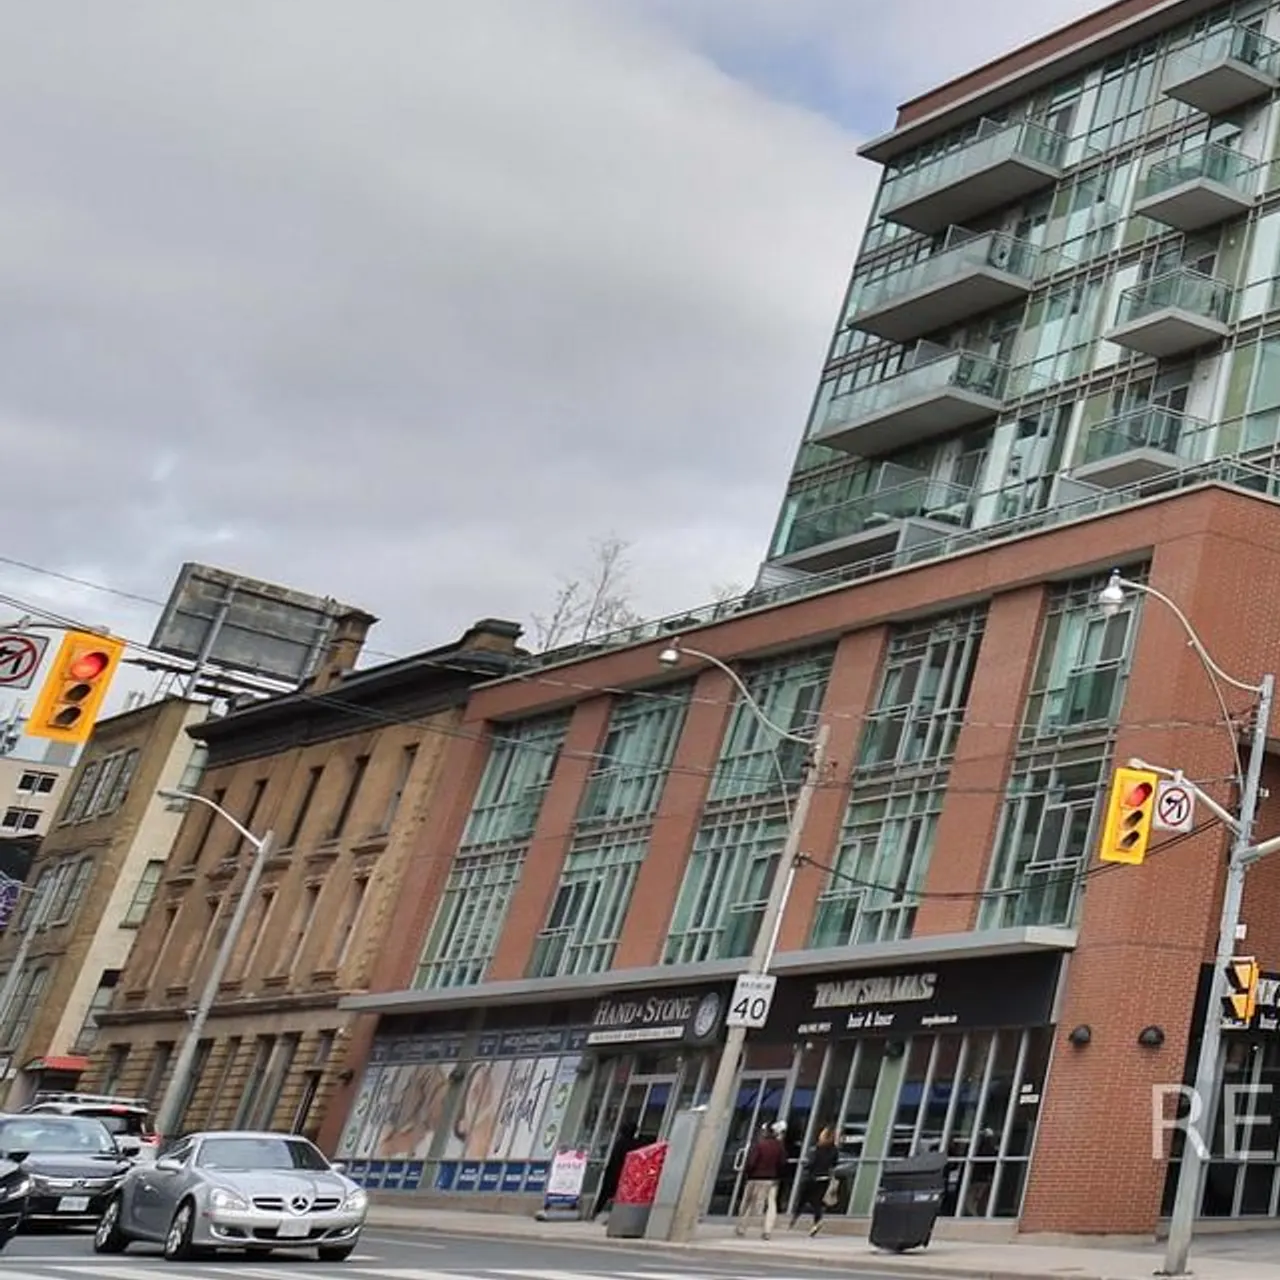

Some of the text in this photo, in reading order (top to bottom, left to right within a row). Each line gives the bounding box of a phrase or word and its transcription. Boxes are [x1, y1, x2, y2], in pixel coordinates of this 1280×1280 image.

[594, 1000, 637, 1026] HAND
[643, 995, 693, 1024] STONE
[733, 997, 767, 1020] 40
